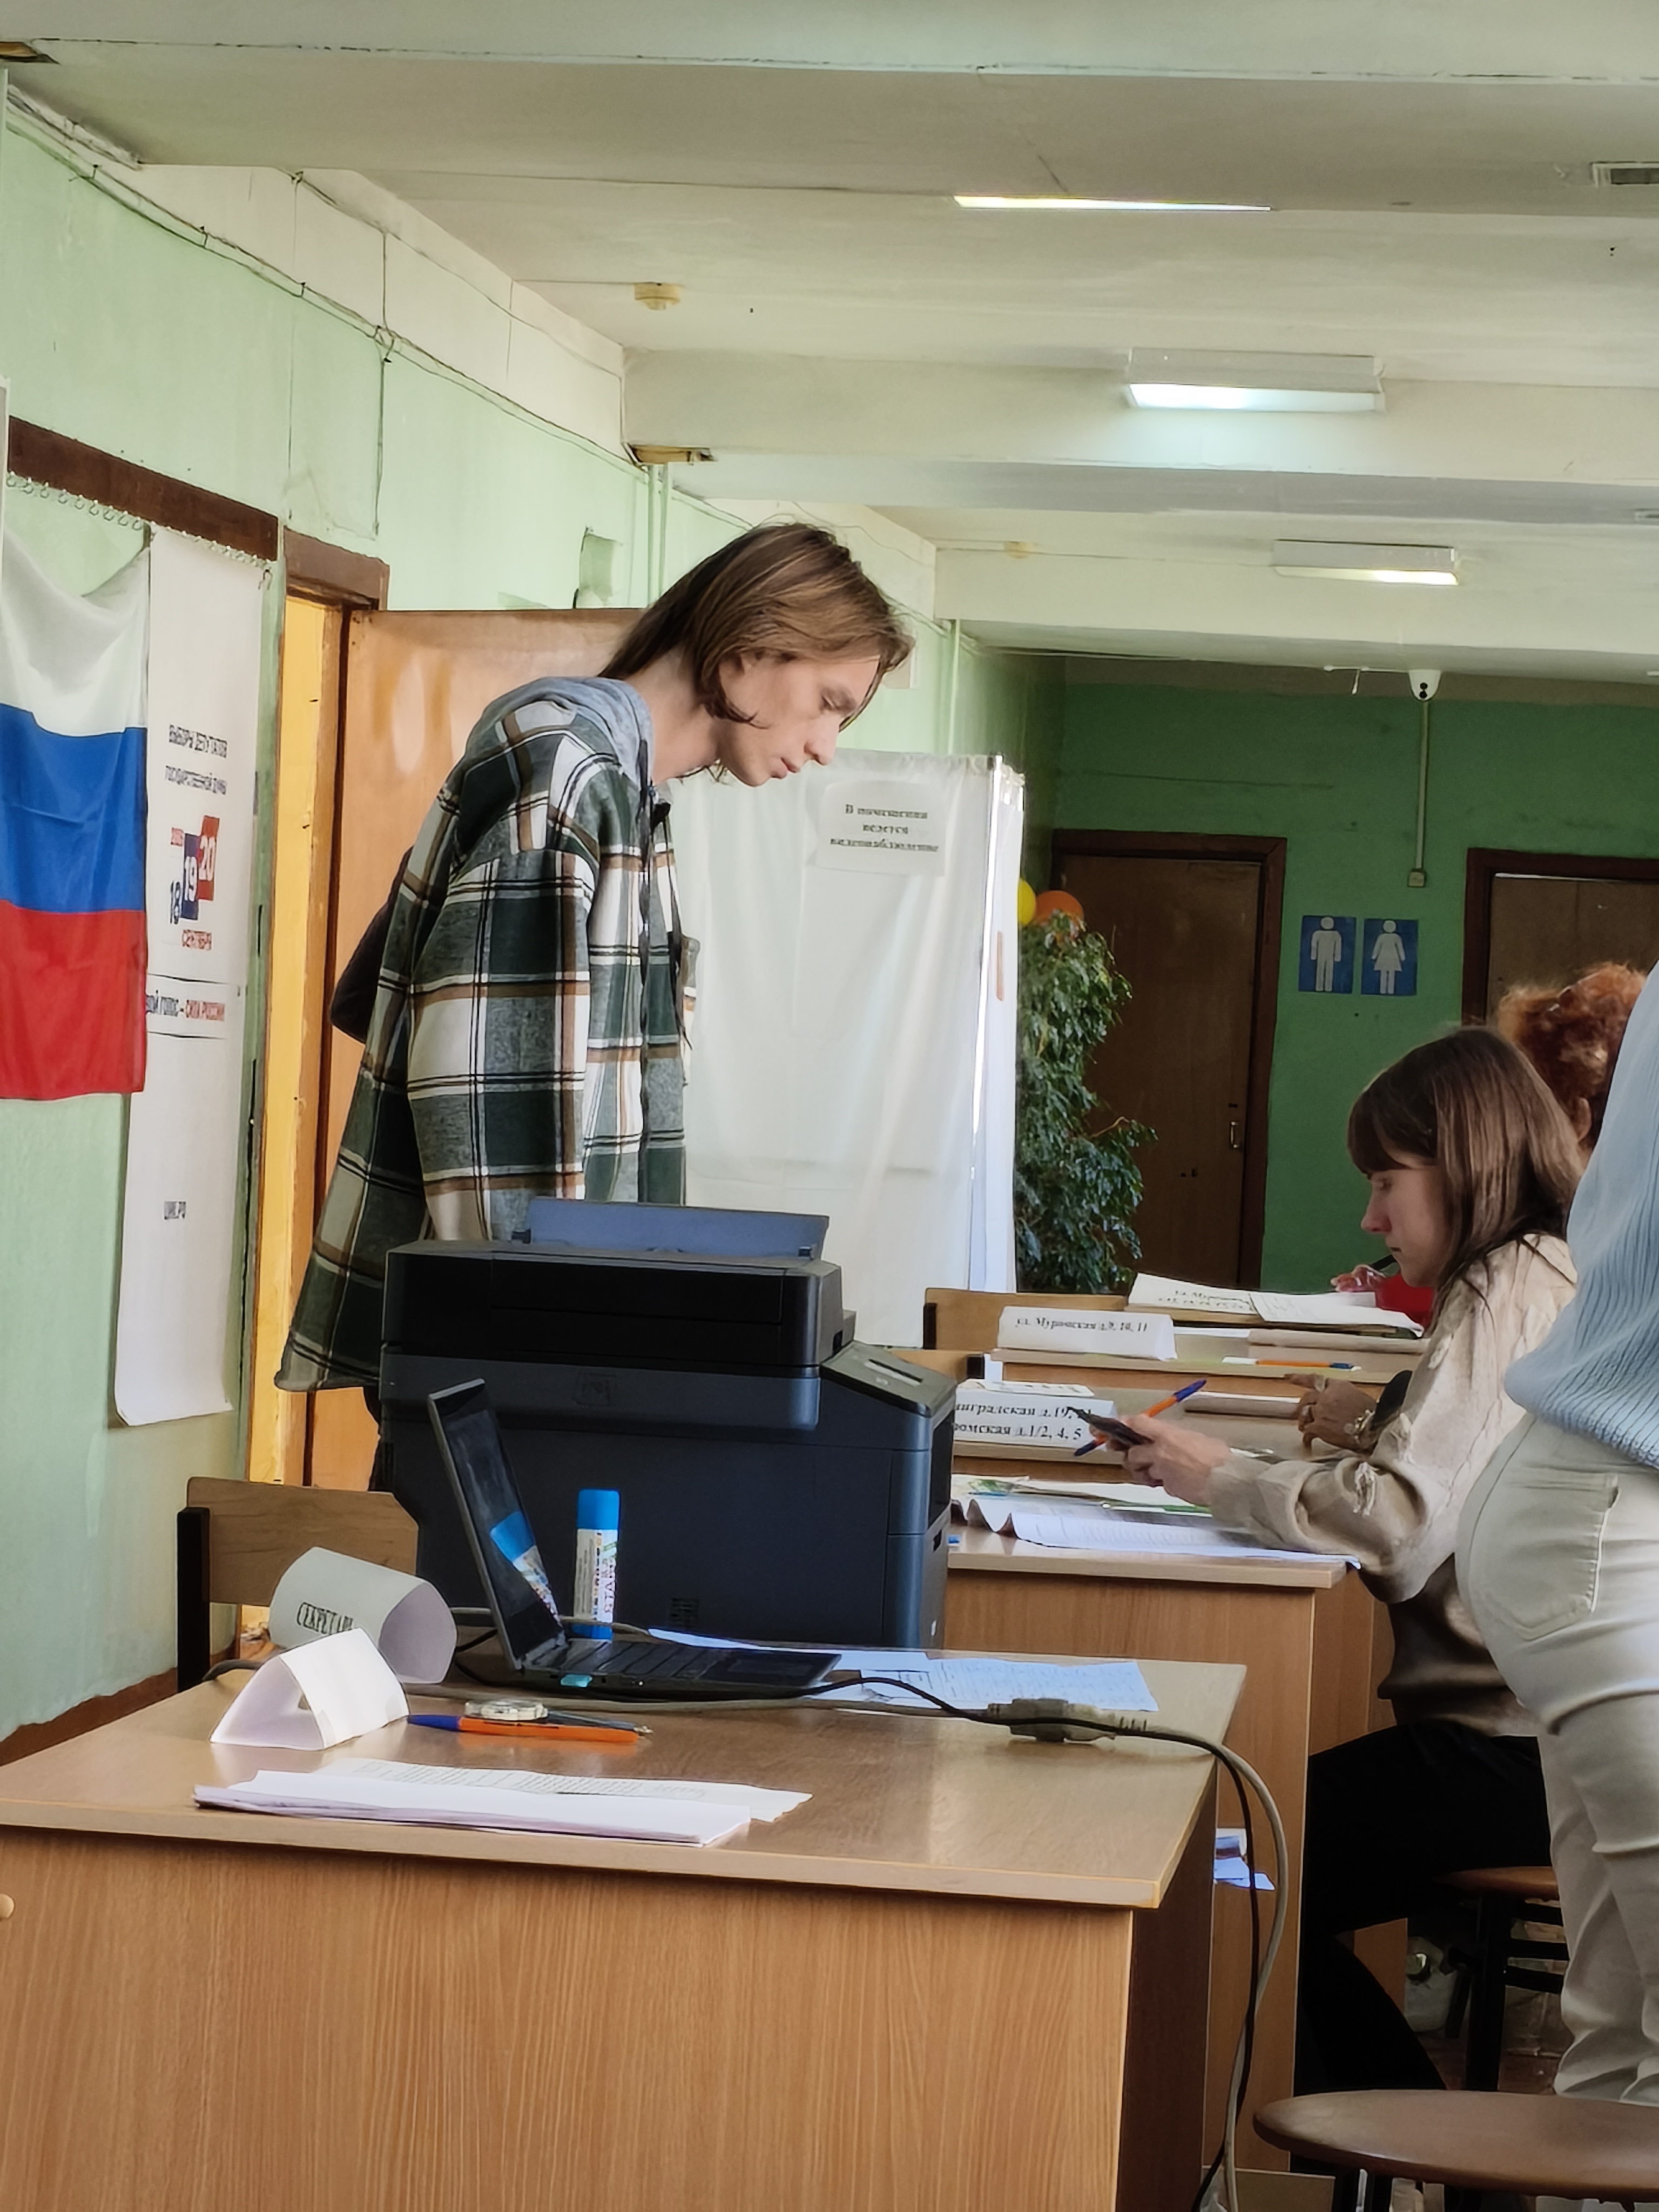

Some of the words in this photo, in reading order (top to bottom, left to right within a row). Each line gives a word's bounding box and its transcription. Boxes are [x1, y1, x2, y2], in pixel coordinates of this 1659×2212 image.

[845, 804, 853, 814] В
[199, 835, 215, 881] 20
[185, 856, 198, 902] 19
[955, 1404, 1036, 1415] инградская
[954, 1423, 1011, 1435] омская
[1073, 1428, 1082, 1441] 5
